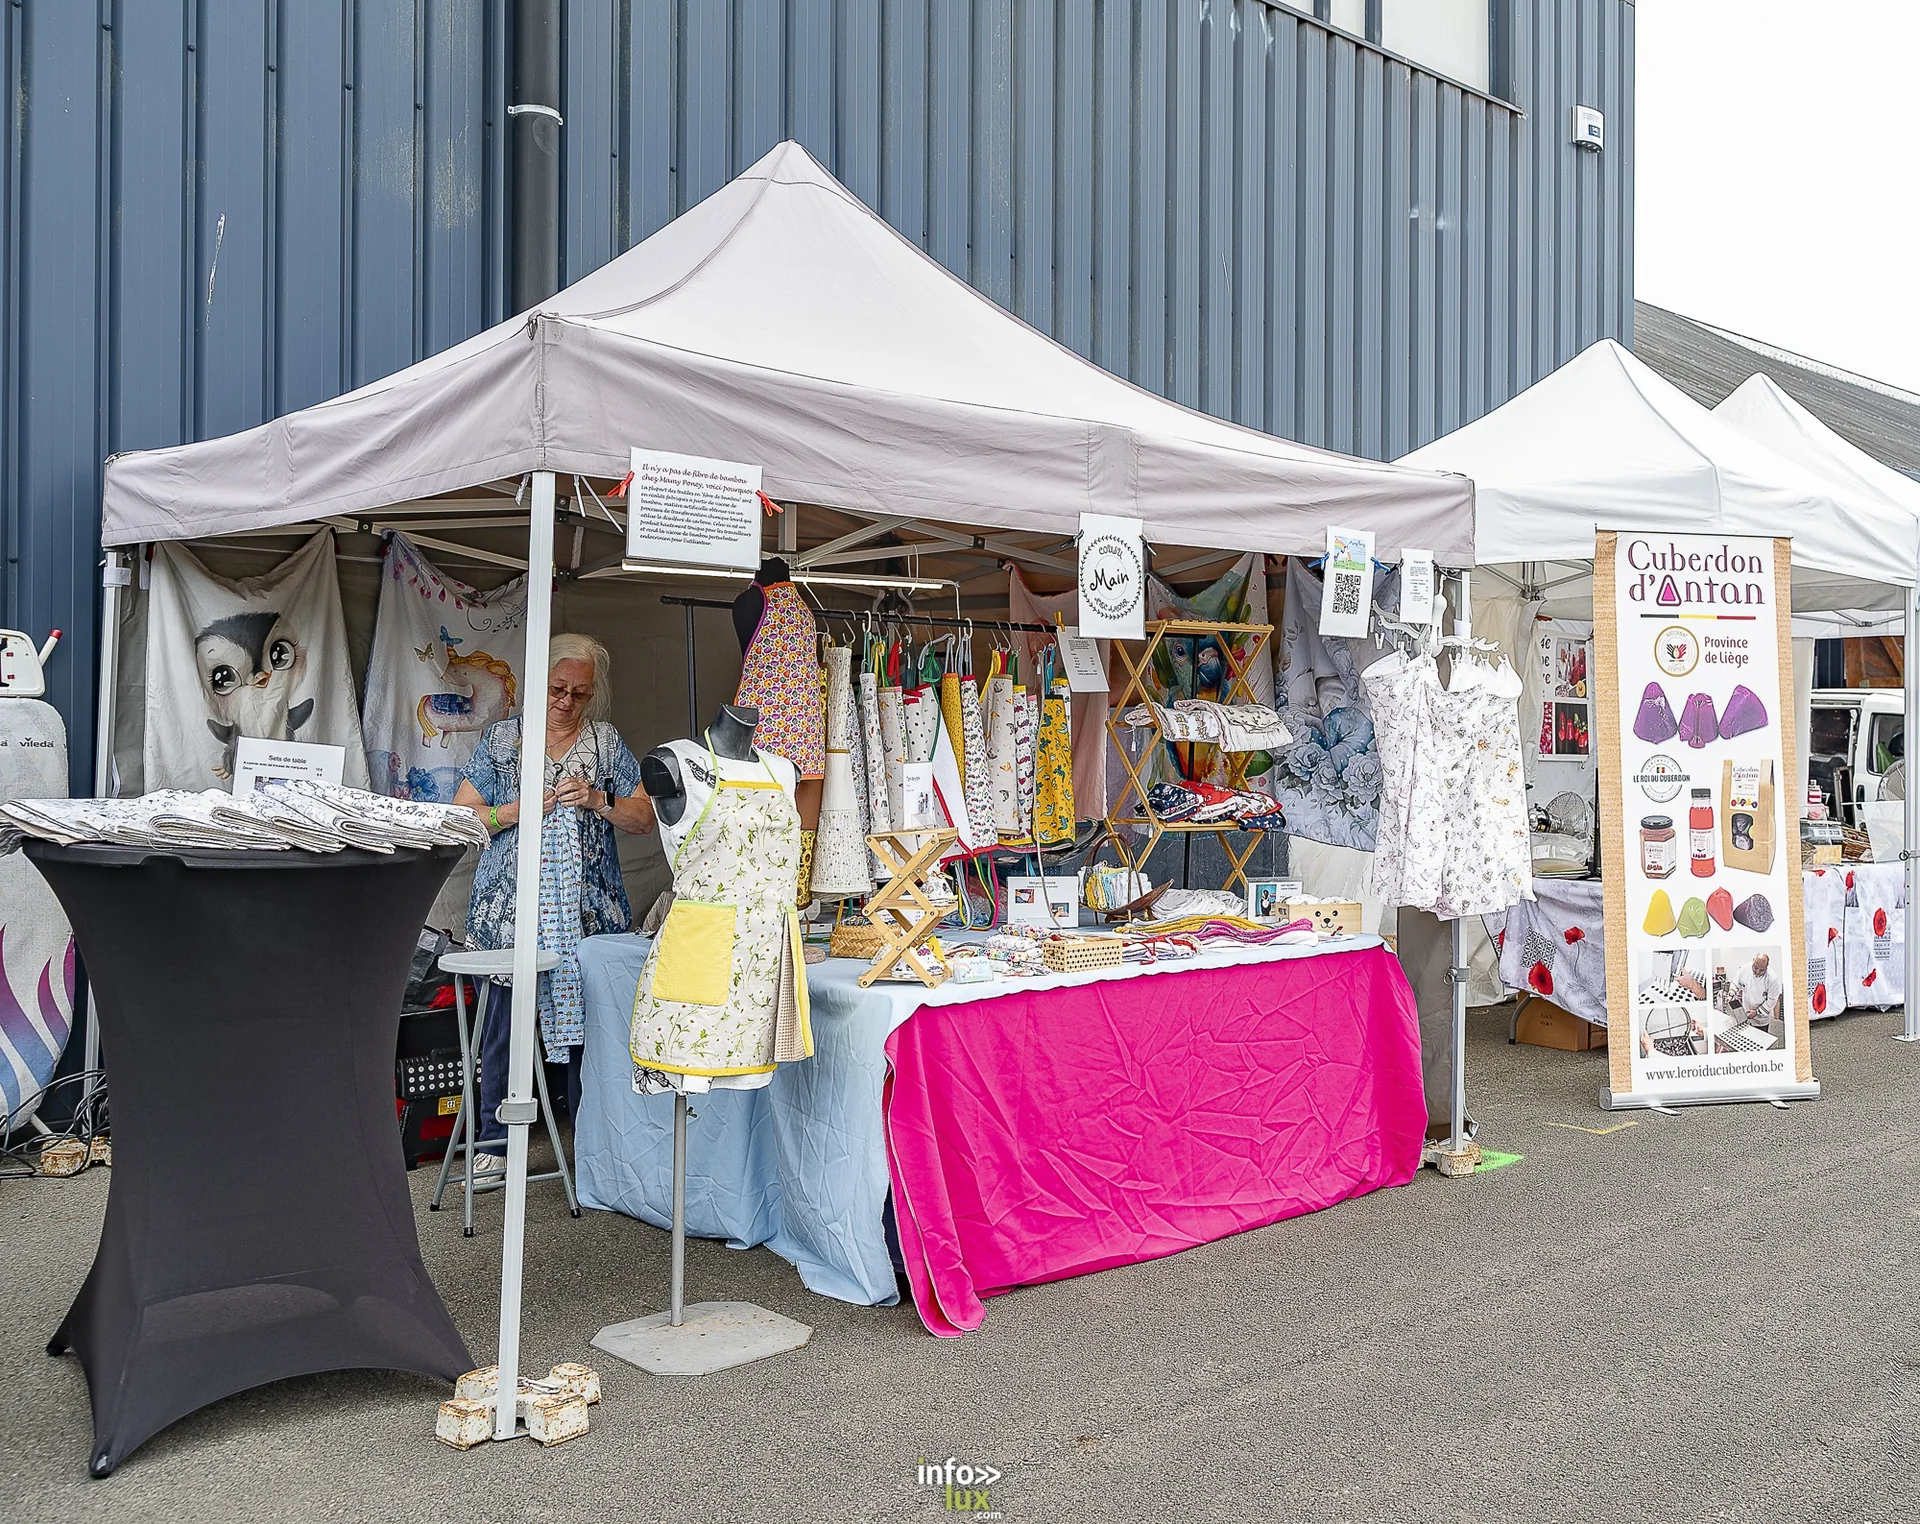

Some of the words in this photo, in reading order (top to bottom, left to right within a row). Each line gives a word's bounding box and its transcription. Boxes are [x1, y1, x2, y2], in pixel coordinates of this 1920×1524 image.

[641, 473, 659, 484] chez
[660, 476, 681, 487] Mamy
[722, 485, 754, 495] pourquoi
[642, 463, 649, 471] Il
[668, 468, 681, 476] pas
[692, 470, 709, 478] fibre
[709, 472, 719, 480] de
[719, 474, 748, 484] bambou
[1628, 540, 1764, 573] Cuberdon
[1090, 568, 1130, 591] Main
[1704, 636, 1749, 649] Province
[1705, 651, 1718, 664] de
[1719, 651, 1749, 669] Liège
[20, 737, 54, 748] vileda
[1660, 774, 1690, 782] CUBERDON
[1646, 1060, 1784, 1081] www.leroiducuberdon.be
